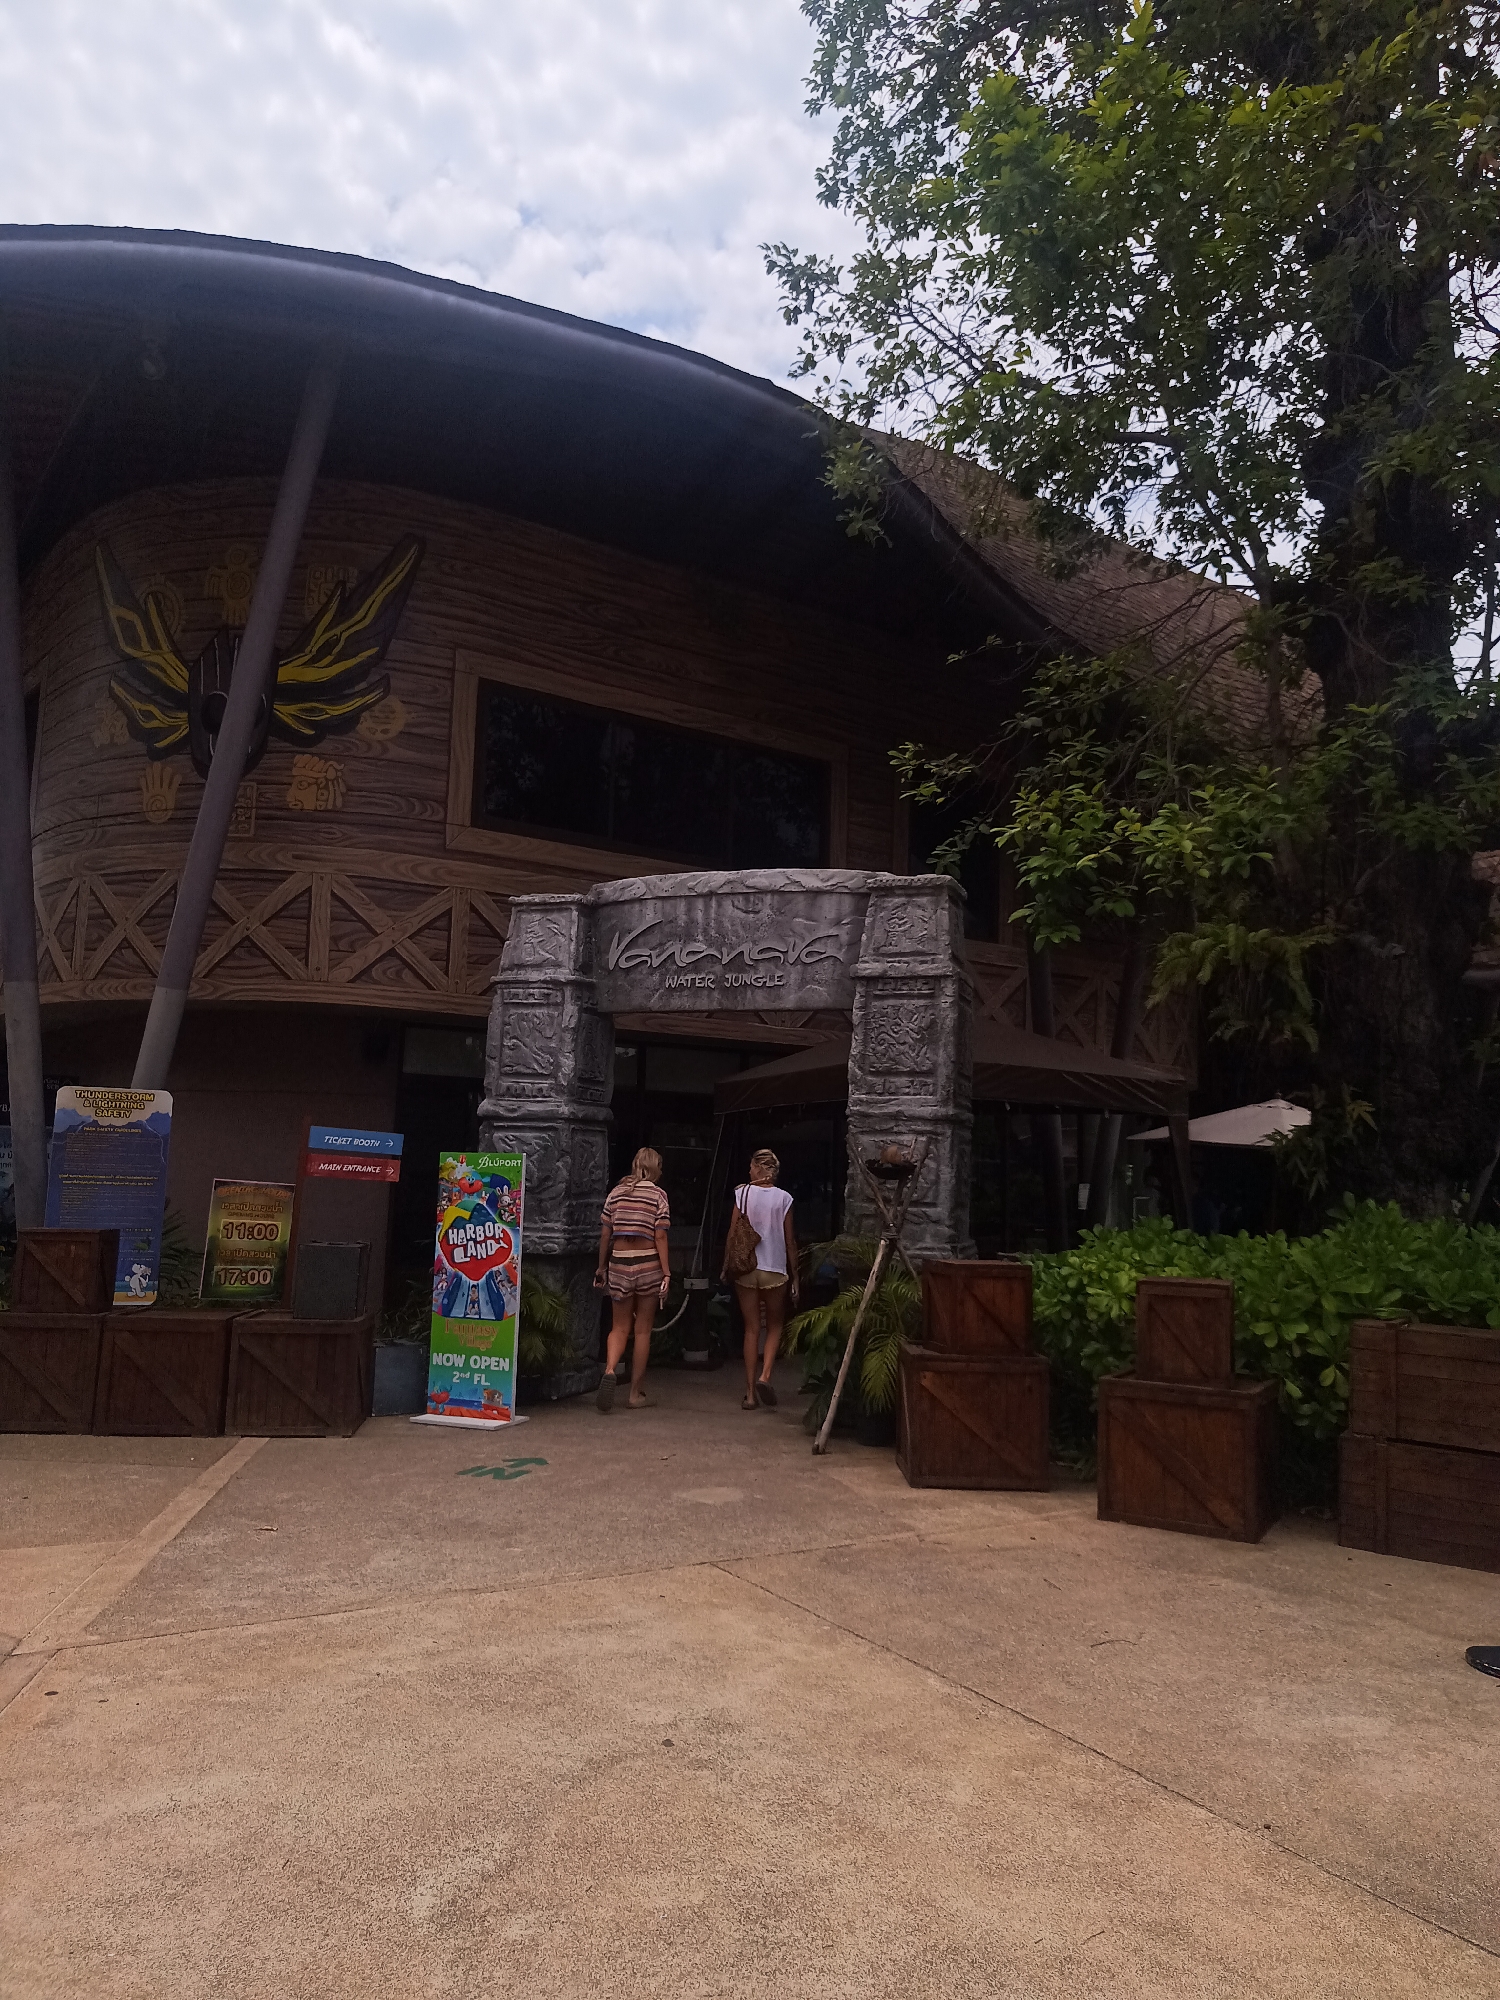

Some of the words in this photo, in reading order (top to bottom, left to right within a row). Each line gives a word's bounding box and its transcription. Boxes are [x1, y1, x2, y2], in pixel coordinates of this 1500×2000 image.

[665, 974, 716, 989] WATER
[723, 973, 784, 988] JUNGLE
[75, 1090, 155, 1102] THUNDERSTORM
[83, 1099, 91, 1107] &
[92, 1101, 145, 1110] LIGHTNING
[95, 1109, 132, 1118] SAFETY
[324, 1135, 353, 1145] TICKET
[353, 1138, 381, 1147] BOOTH
[318, 1163, 342, 1171] MAIN
[343, 1164, 382, 1173] ENTRANCE
[223, 1221, 279, 1241] 11:00
[448, 1221, 504, 1246] HARBOR
[453, 1239, 509, 1263] LAND
[218, 1267, 272, 1286] 17:00
[444, 1318, 500, 1337] Fantasy
[432, 1352, 466, 1368] NOW
[469, 1355, 510, 1372] OPEN
[452, 1371, 471, 1383] 2nd
[473, 1373, 491, 1386] FL
